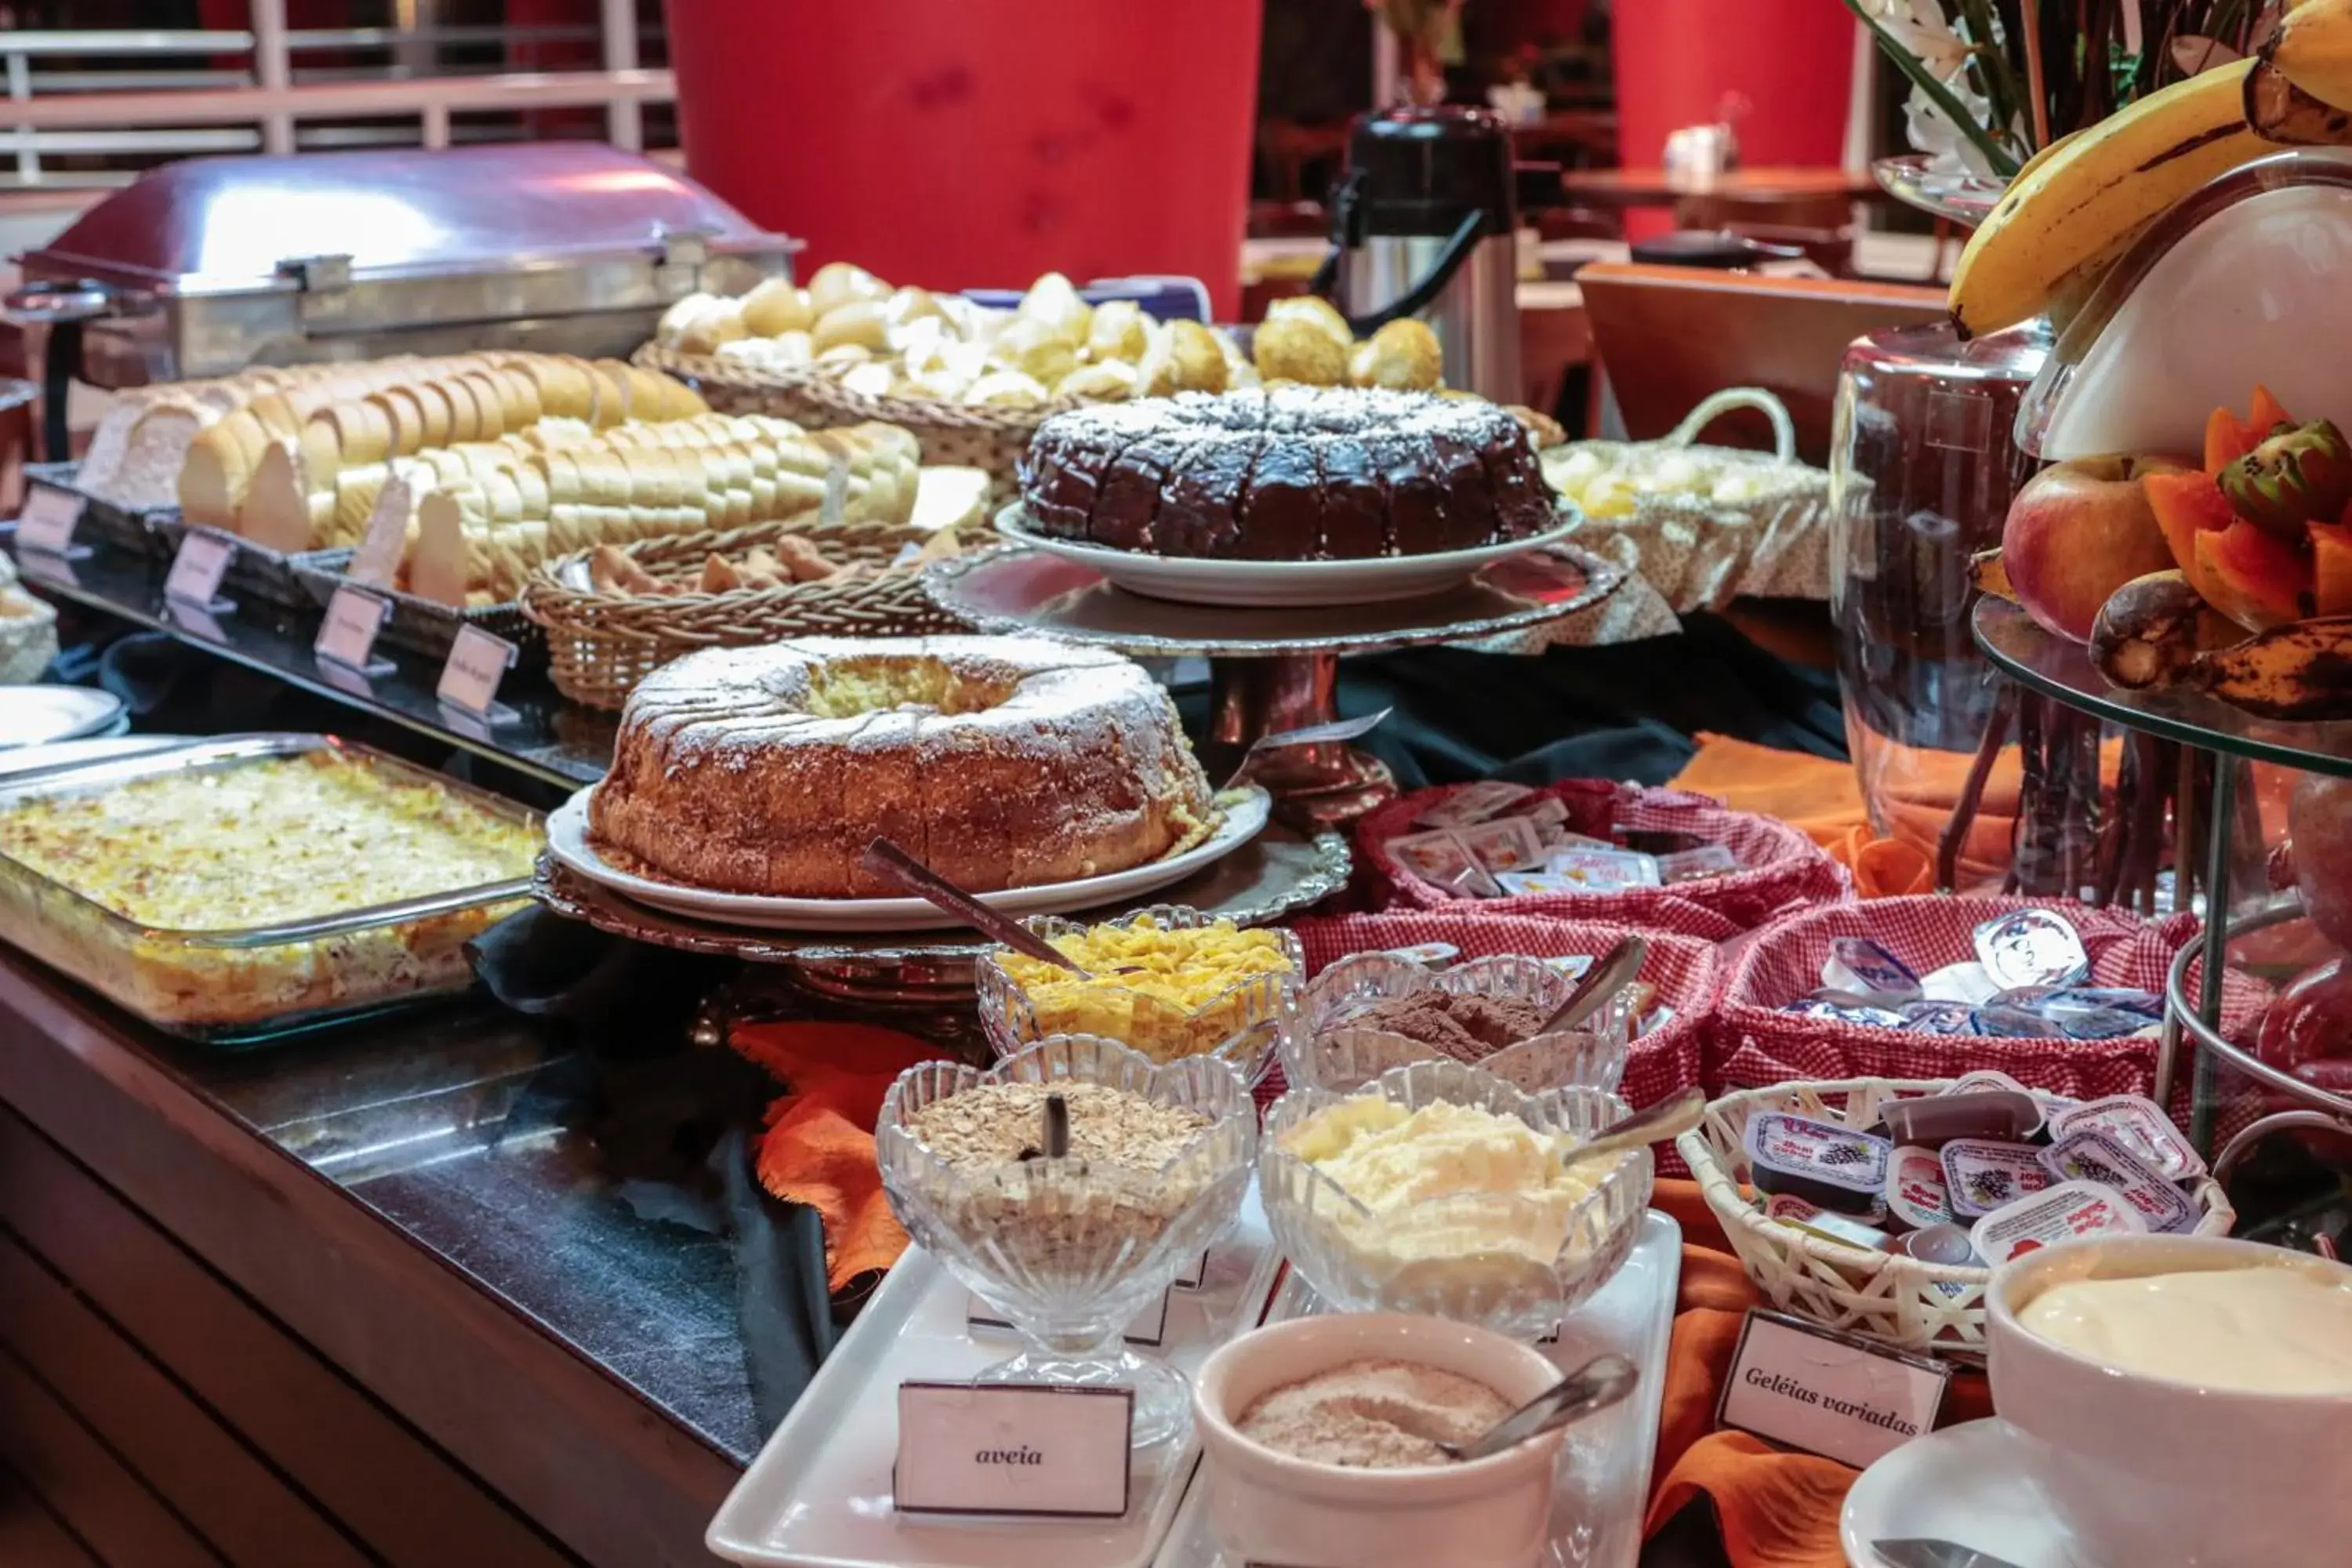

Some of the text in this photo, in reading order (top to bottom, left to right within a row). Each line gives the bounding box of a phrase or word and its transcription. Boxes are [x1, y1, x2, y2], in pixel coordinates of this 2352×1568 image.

[1744, 1367, 1918, 1437] Geléias variadas
[975, 1445, 1043, 1465] aveia
